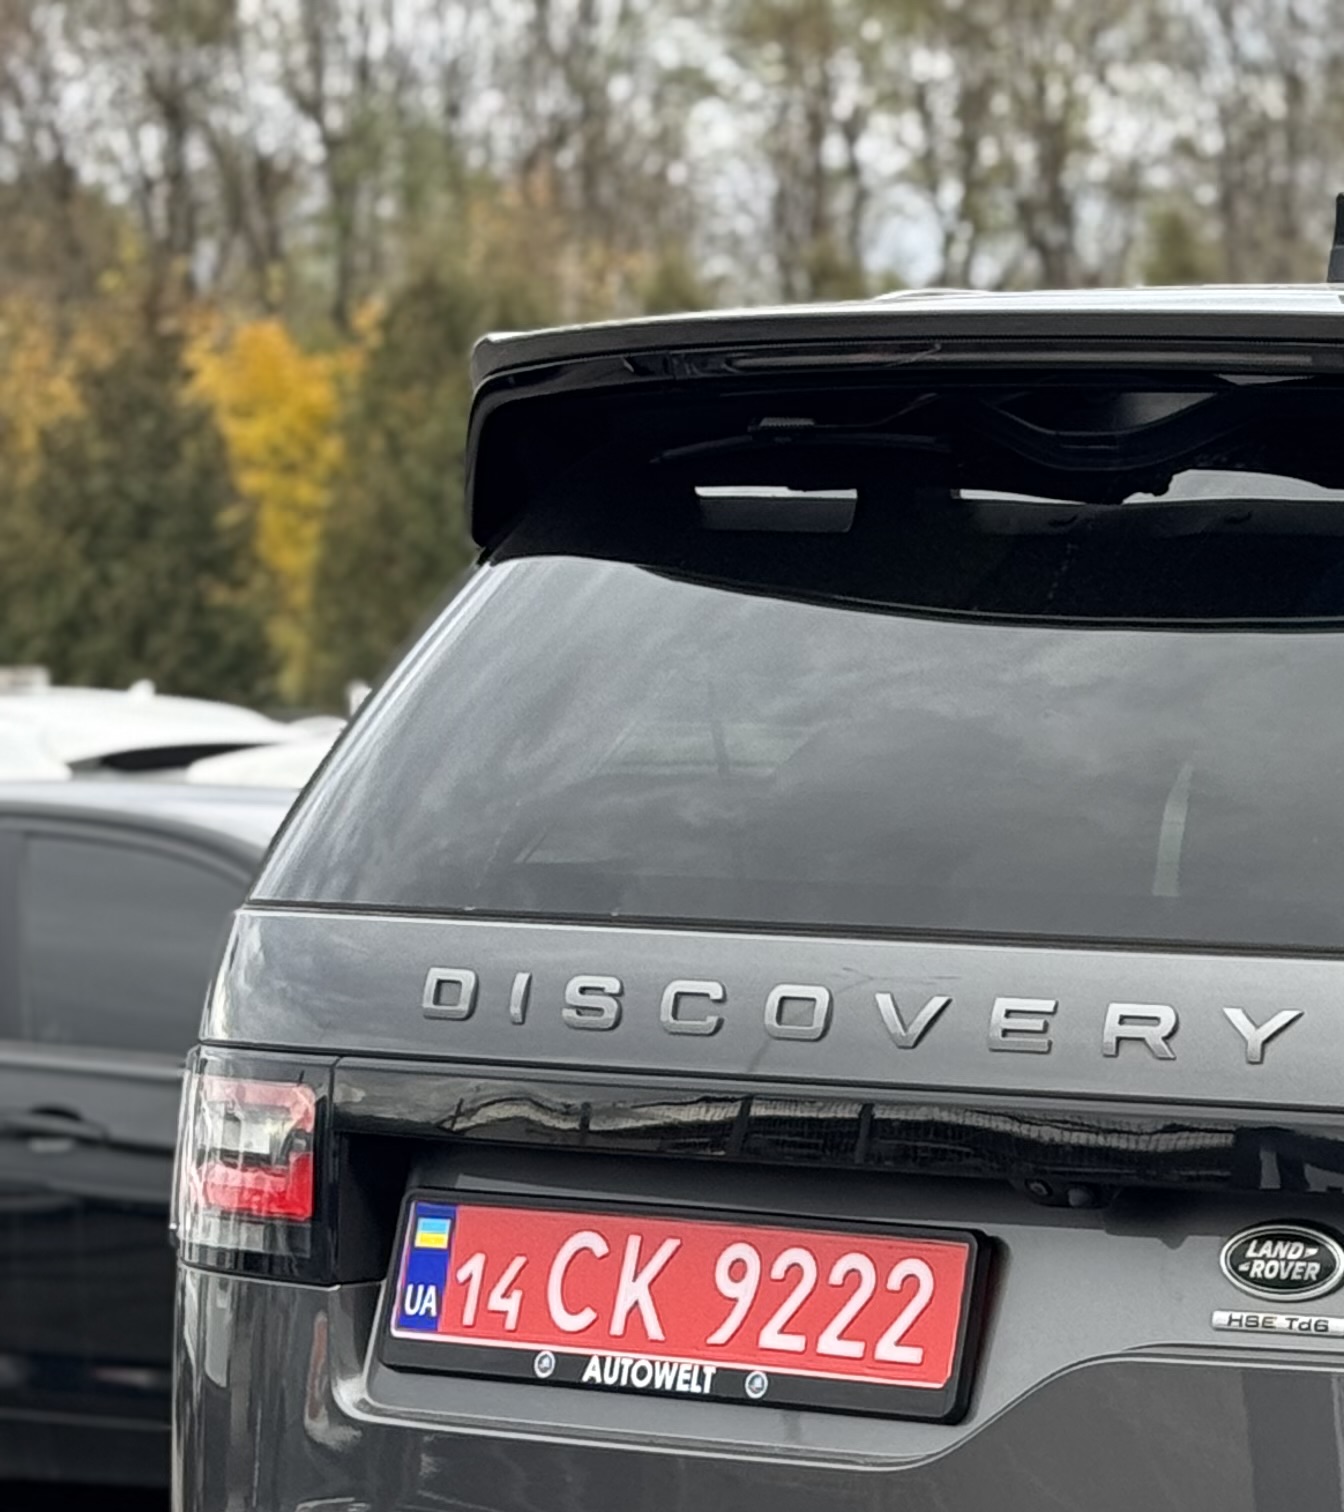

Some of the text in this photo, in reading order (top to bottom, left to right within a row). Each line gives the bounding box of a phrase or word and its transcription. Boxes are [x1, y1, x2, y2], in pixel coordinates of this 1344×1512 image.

[421, 966, 1304, 1064] DISCOVERY
[1245, 1239, 1304, 1260] LAND
[1249, 1259, 1320, 1281] ROVER
[404, 1283, 438, 1317] UA
[455, 1252, 529, 1332] 14
[705, 1241, 935, 1365] 9222
[1226, 1313, 1330, 1333] HSE Td6
[582, 1354, 717, 1394] AUTOWELT
